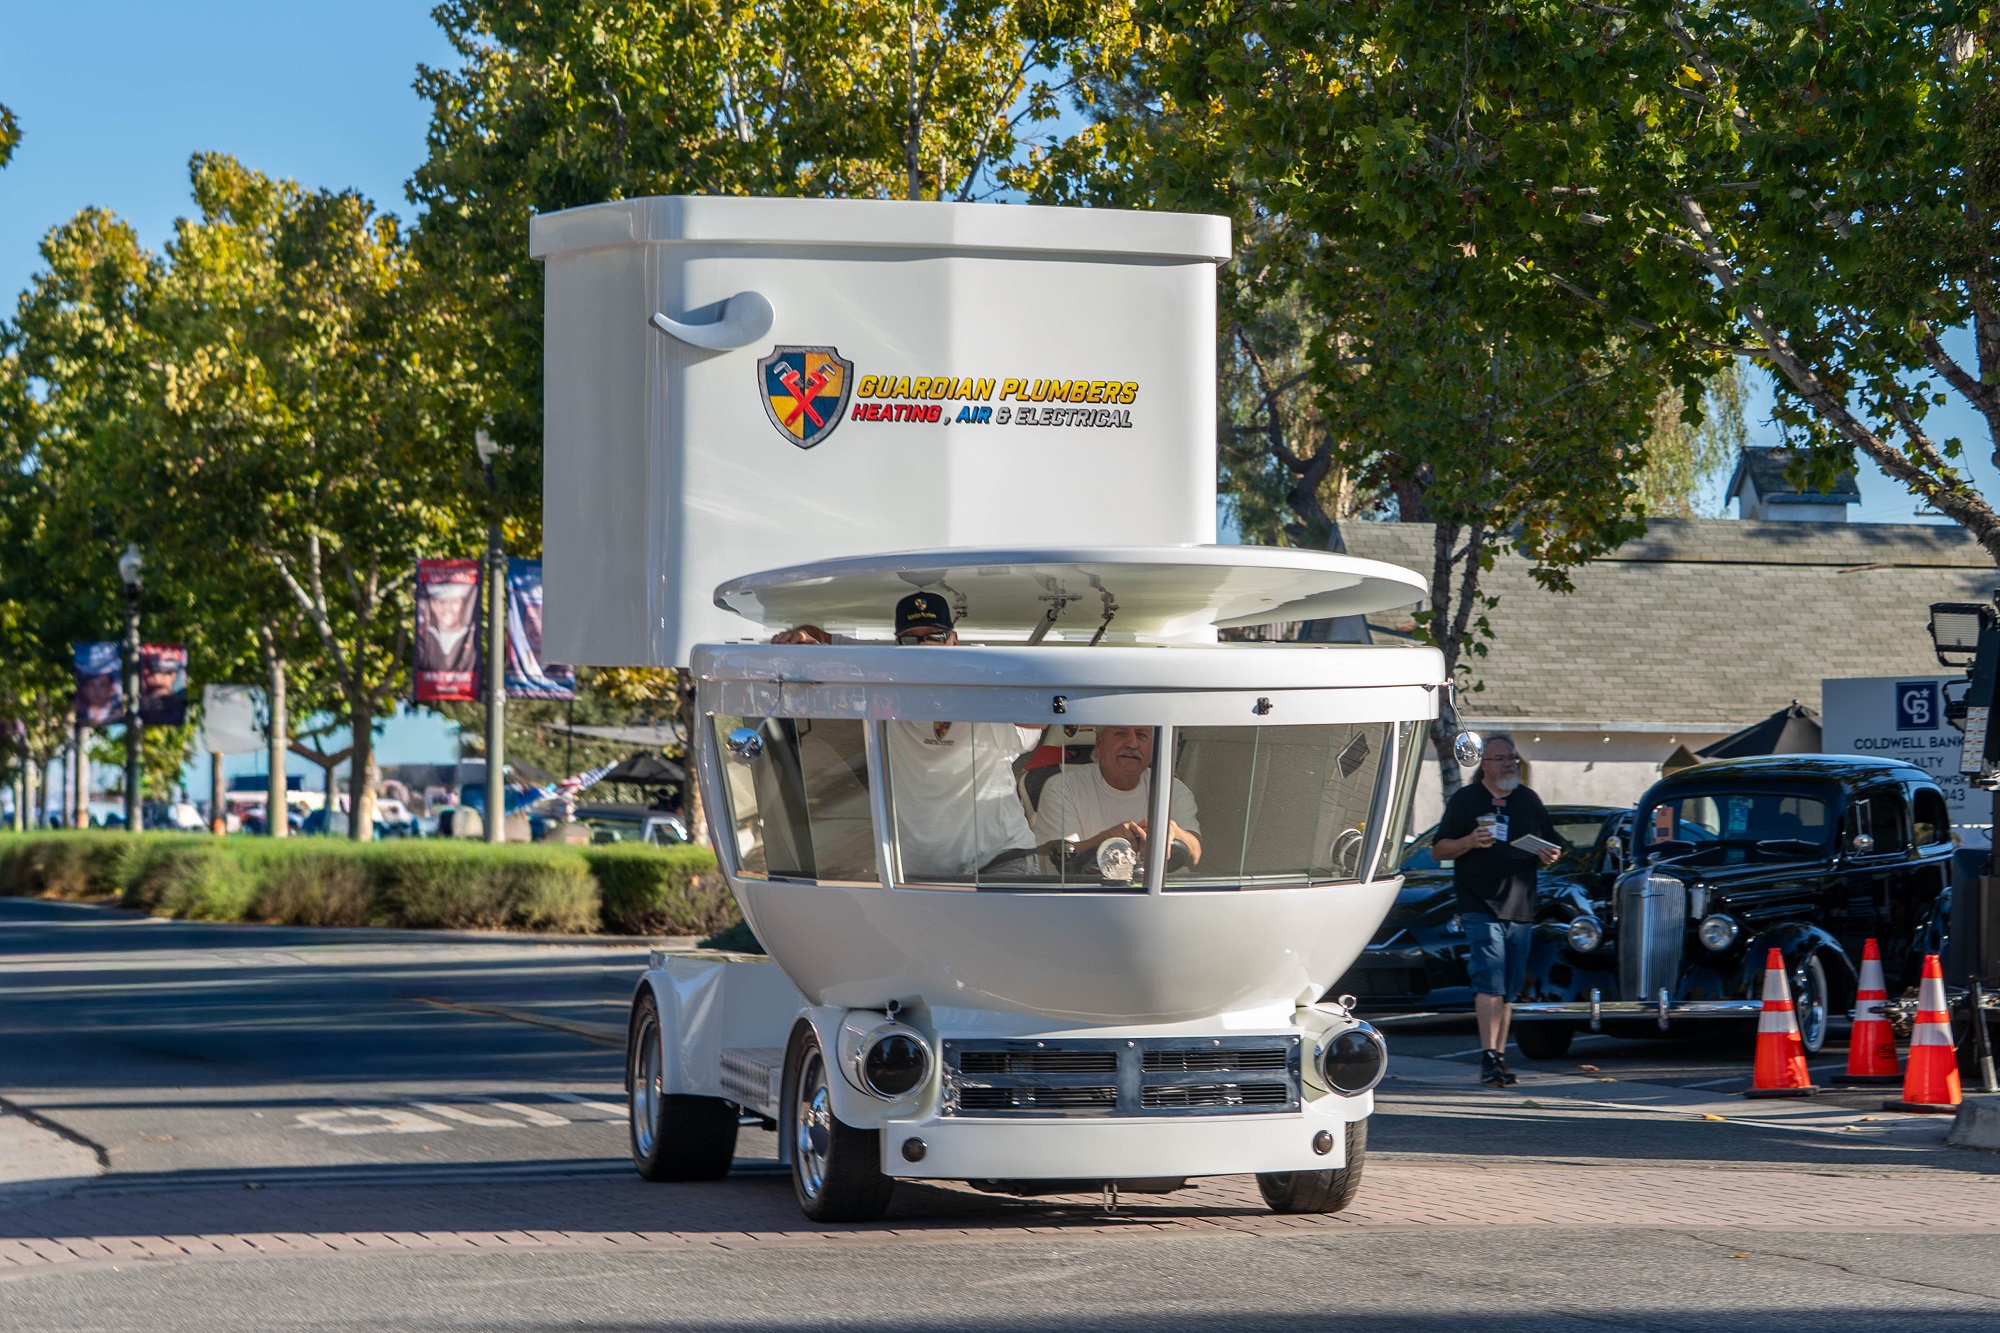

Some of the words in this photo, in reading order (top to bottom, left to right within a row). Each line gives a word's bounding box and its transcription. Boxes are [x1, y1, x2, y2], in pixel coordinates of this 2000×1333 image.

[857, 375, 996, 401] GUARDIAN
[999, 378, 1138, 404] PLUMBERS
[955, 405, 992, 424] AIR
[996, 407, 1012, 424] &
[1015, 407, 1133, 428] ELECTRICAL
[1854, 737, 1926, 750] COLDWELL
[1930, 736, 1965, 748] BANK
[1895, 756, 1944, 769] ALTY
